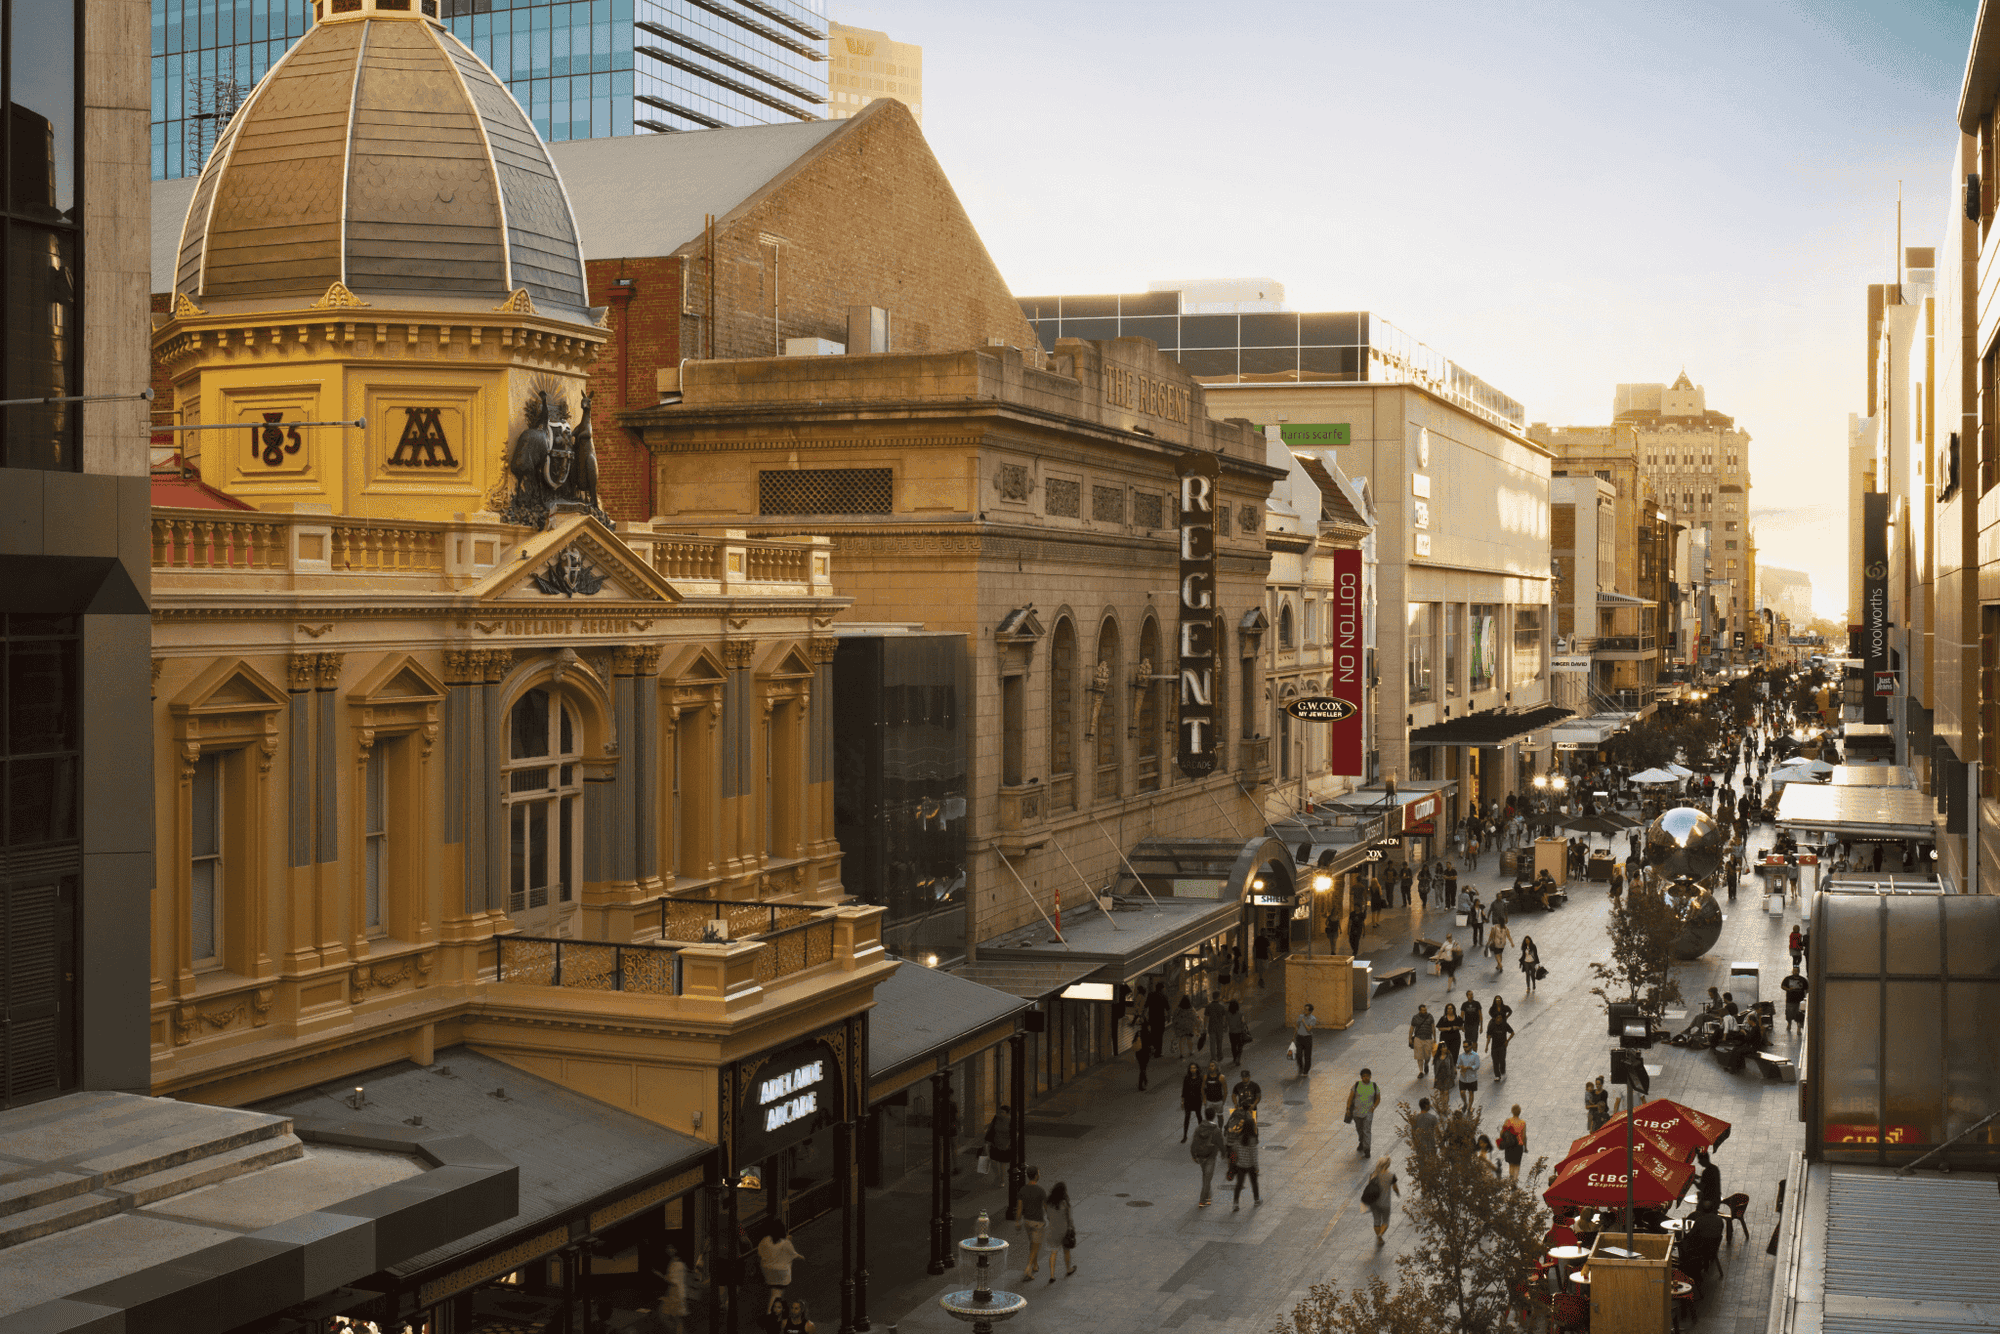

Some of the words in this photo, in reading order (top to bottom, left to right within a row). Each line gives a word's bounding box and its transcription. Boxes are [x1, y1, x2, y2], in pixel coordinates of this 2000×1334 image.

[1105, 364, 1133, 409] THE
[1139, 375, 1190, 425] REGENT
[1281, 429, 1310, 440] harris
[1312, 428, 1342, 440] scarfe
[505, 619, 573, 635] ADELAIDE
[580, 618, 629, 634] ARCADE
[1180, 475, 1213, 754] REGENT
[1340, 573, 1356, 648] COTTON
[1869, 588, 1883, 658] Woolworths
[1339, 655, 1355, 682] ON
[1320, 701, 1343, 711] COX
[1261, 895, 1288, 903] SHIELS
[759, 1060, 823, 1105] ADELAIDE
[765, 1091, 818, 1132] ARCADE
[1633, 1119, 1672, 1129] CIBO
